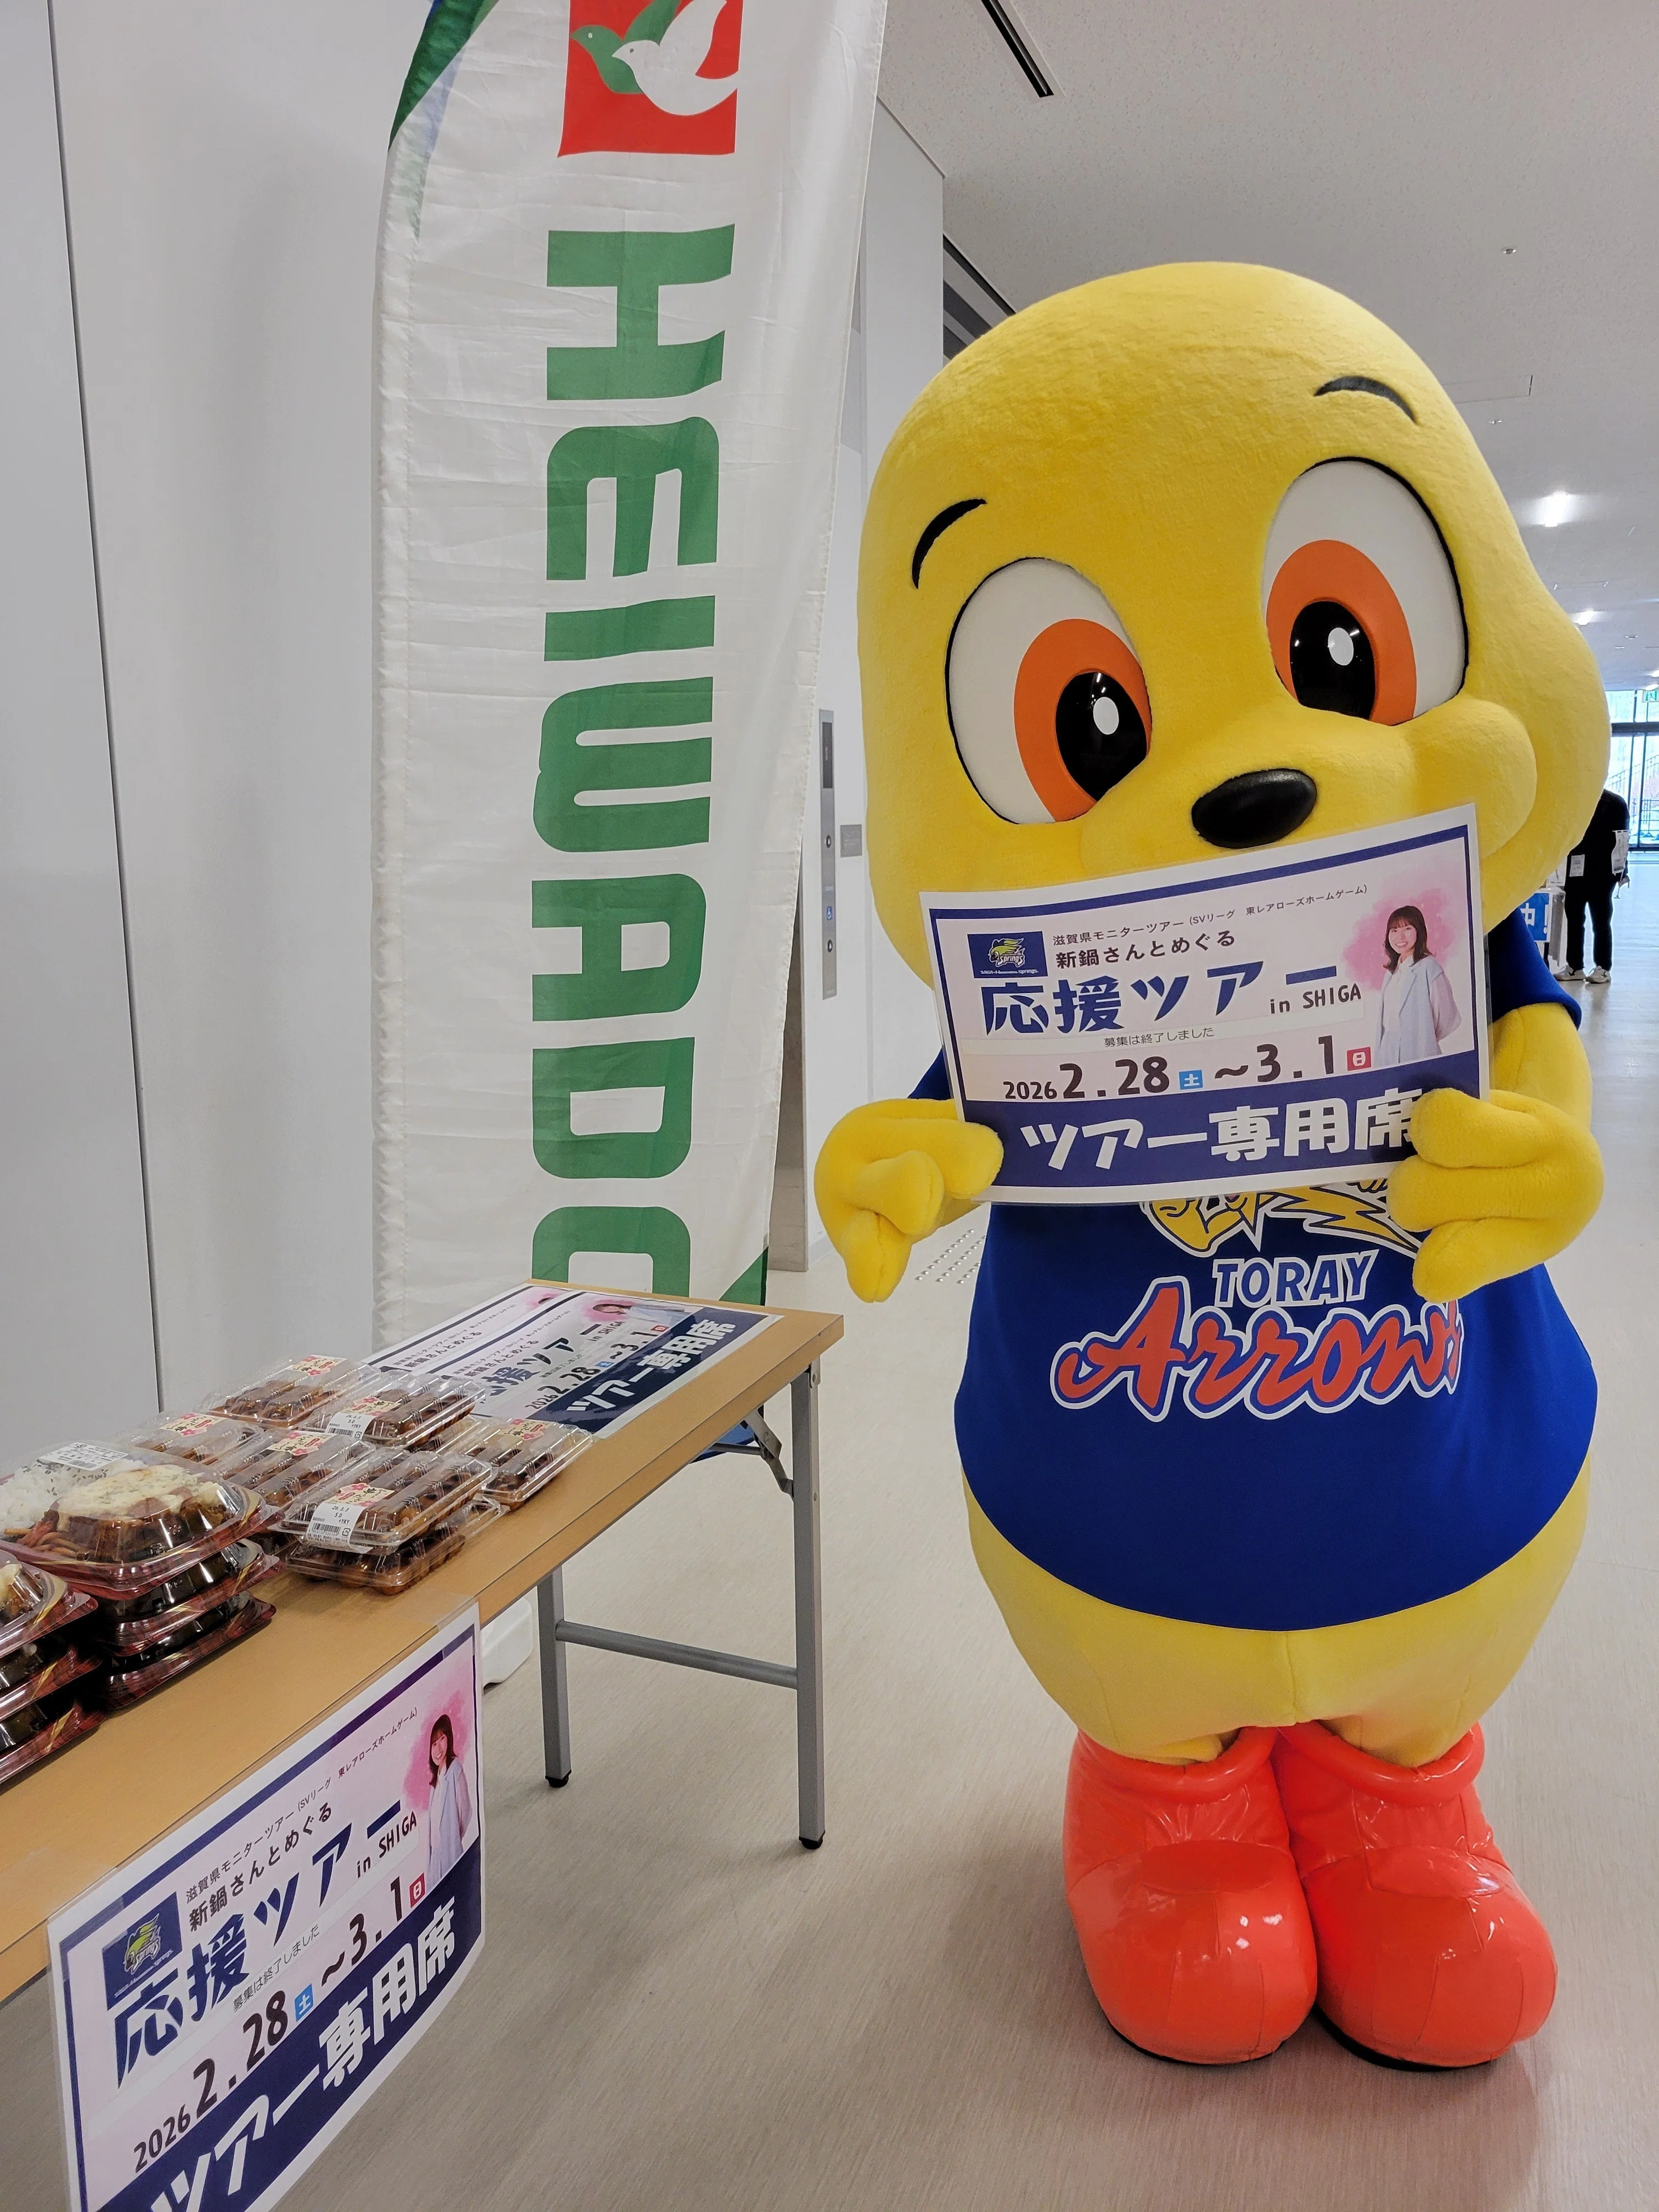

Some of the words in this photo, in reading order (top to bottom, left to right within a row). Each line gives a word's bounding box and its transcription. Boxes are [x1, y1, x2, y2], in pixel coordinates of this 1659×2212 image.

[1053, 921, 1184, 946] 滋賀県モニターツアー
[1189, 910, 1235, 926] (SVリーグ
[1056, 930, 1235, 969] 新鍋さんとめぐる
[981, 961, 1337, 1035] 応援ツアー
[1270, 998, 1290, 1014] in
[1302, 983, 1362, 1009] SHIGA
[1104, 1026, 1215, 1048] 募集は終了しました
[1003, 1081, 1057, 1100] 2026
[1020, 1087, 1423, 1171] ツアー専用席
[1212, 1249, 1379, 1308] TORAY
[597, 1321, 626, 1335] SHIGA
[566, 1319, 737, 1411] ツアー専用席
[524, 1393, 559, 1409] 2026
[186, 1811, 295, 1904] 滋賀県モニターツアー
[189, 1802, 332, 1932] 新鍋さんとめぐる
[357, 1855, 371, 1878] in
[377, 1810, 417, 1859] SHIGA
[114, 1799, 401, 2089] 応援ツアー
[233, 1924, 320, 2013] 募集は終了しました
[133, 2104, 191, 2174] 2026
